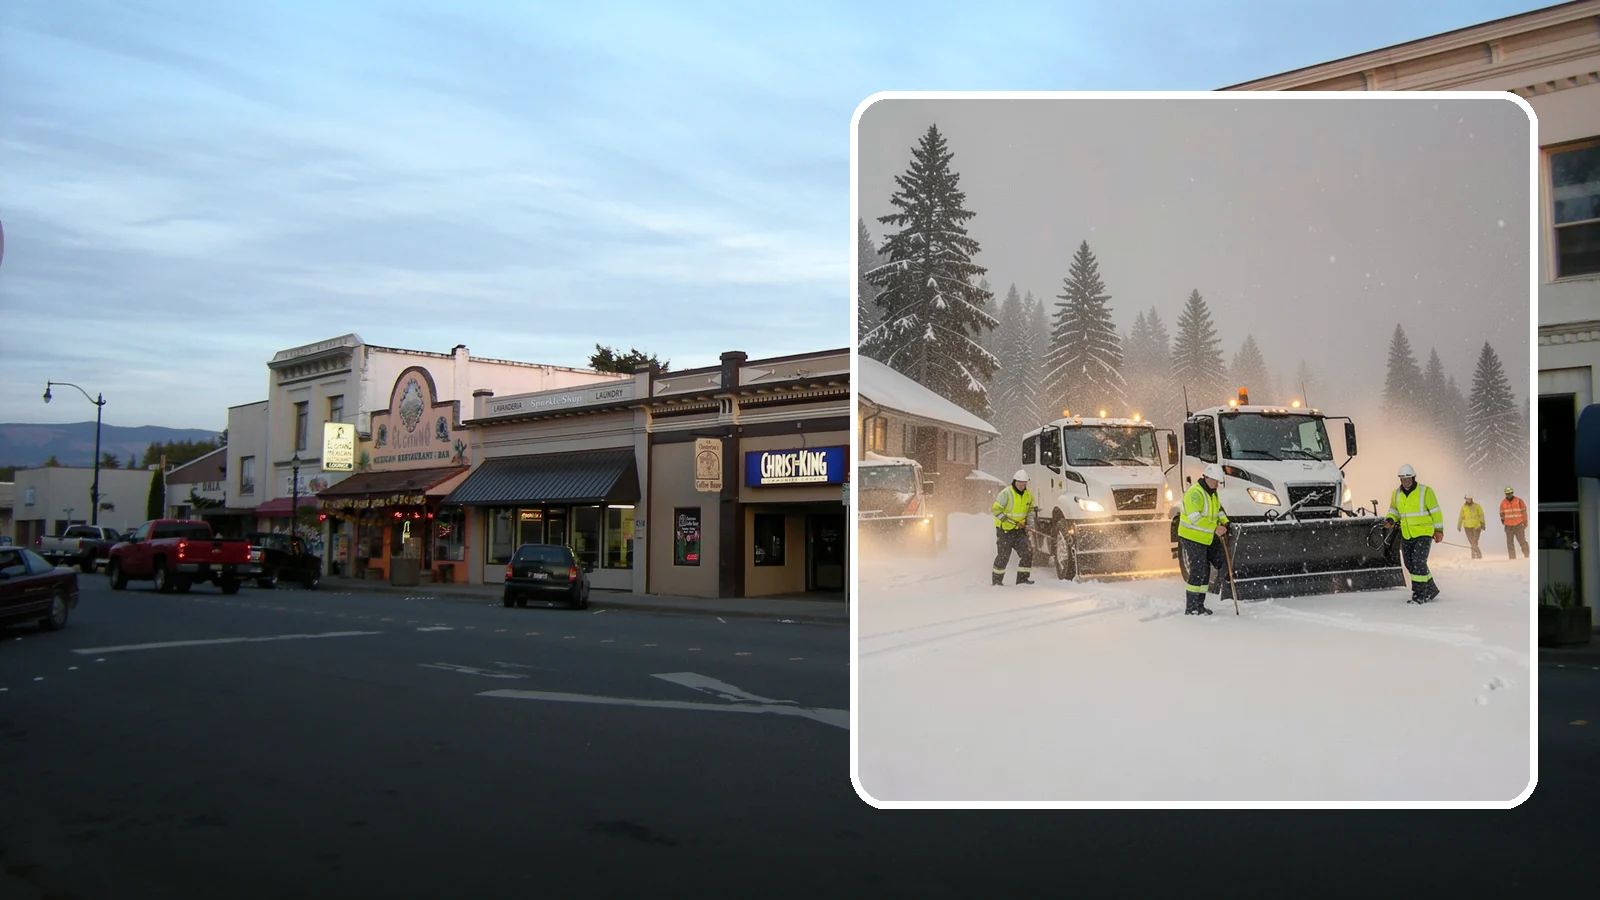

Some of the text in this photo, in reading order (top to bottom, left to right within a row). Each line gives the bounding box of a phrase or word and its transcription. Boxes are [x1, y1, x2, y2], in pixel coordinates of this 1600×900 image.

[595, 389, 623, 400] LAUNDRY
[493, 402, 522, 413] LAVANDERIA
[531, 395, 583, 409] Sparkle Shop
[374, 455, 396, 464] MEXICAN
[397, 451, 433, 462] RESTAURANT
[437, 450, 450, 459] BAR
[761, 450, 827, 478] CHRIST KING
[696, 481, 721, 489] Coffee House
